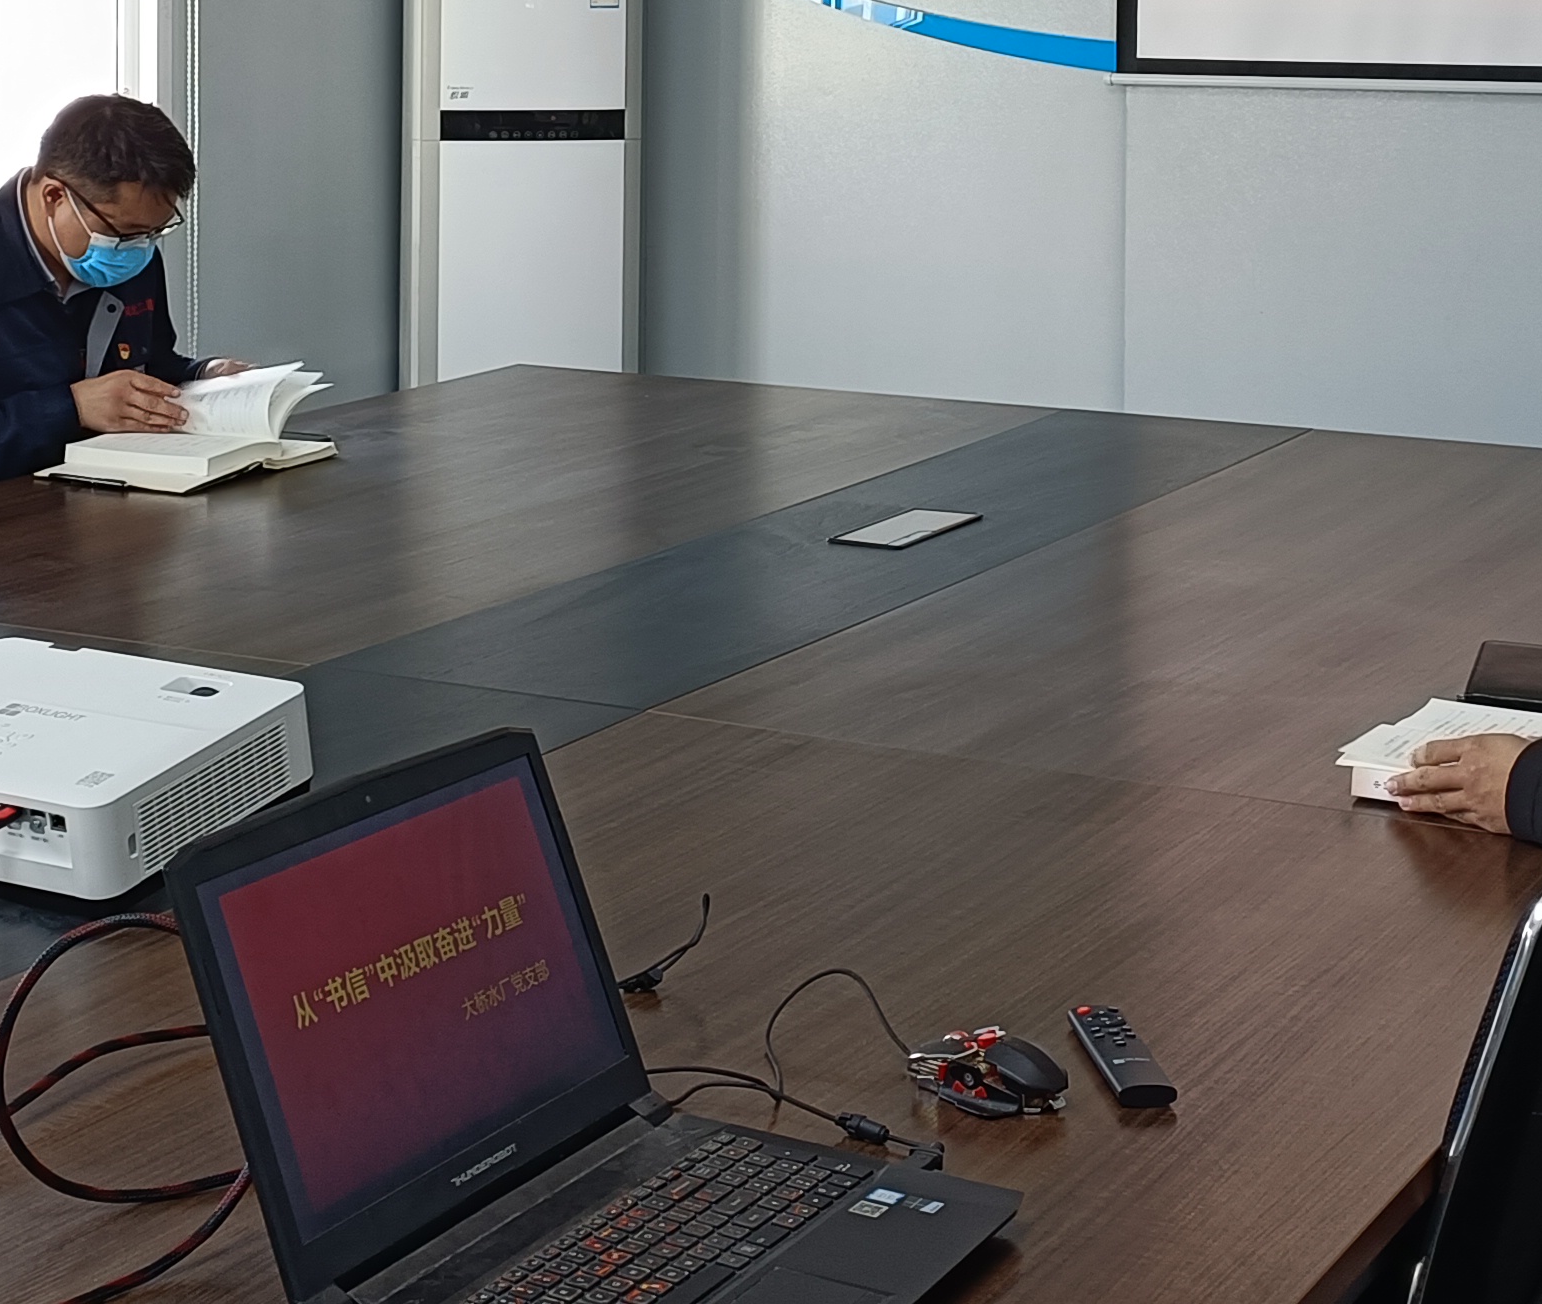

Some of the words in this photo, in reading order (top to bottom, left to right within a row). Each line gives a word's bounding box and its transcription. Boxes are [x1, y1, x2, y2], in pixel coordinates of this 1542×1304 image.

[292, 893, 526, 1030] 从“书信”中汲取奋进“力量”
[461, 959, 550, 1020] 大桥水厂党支部
